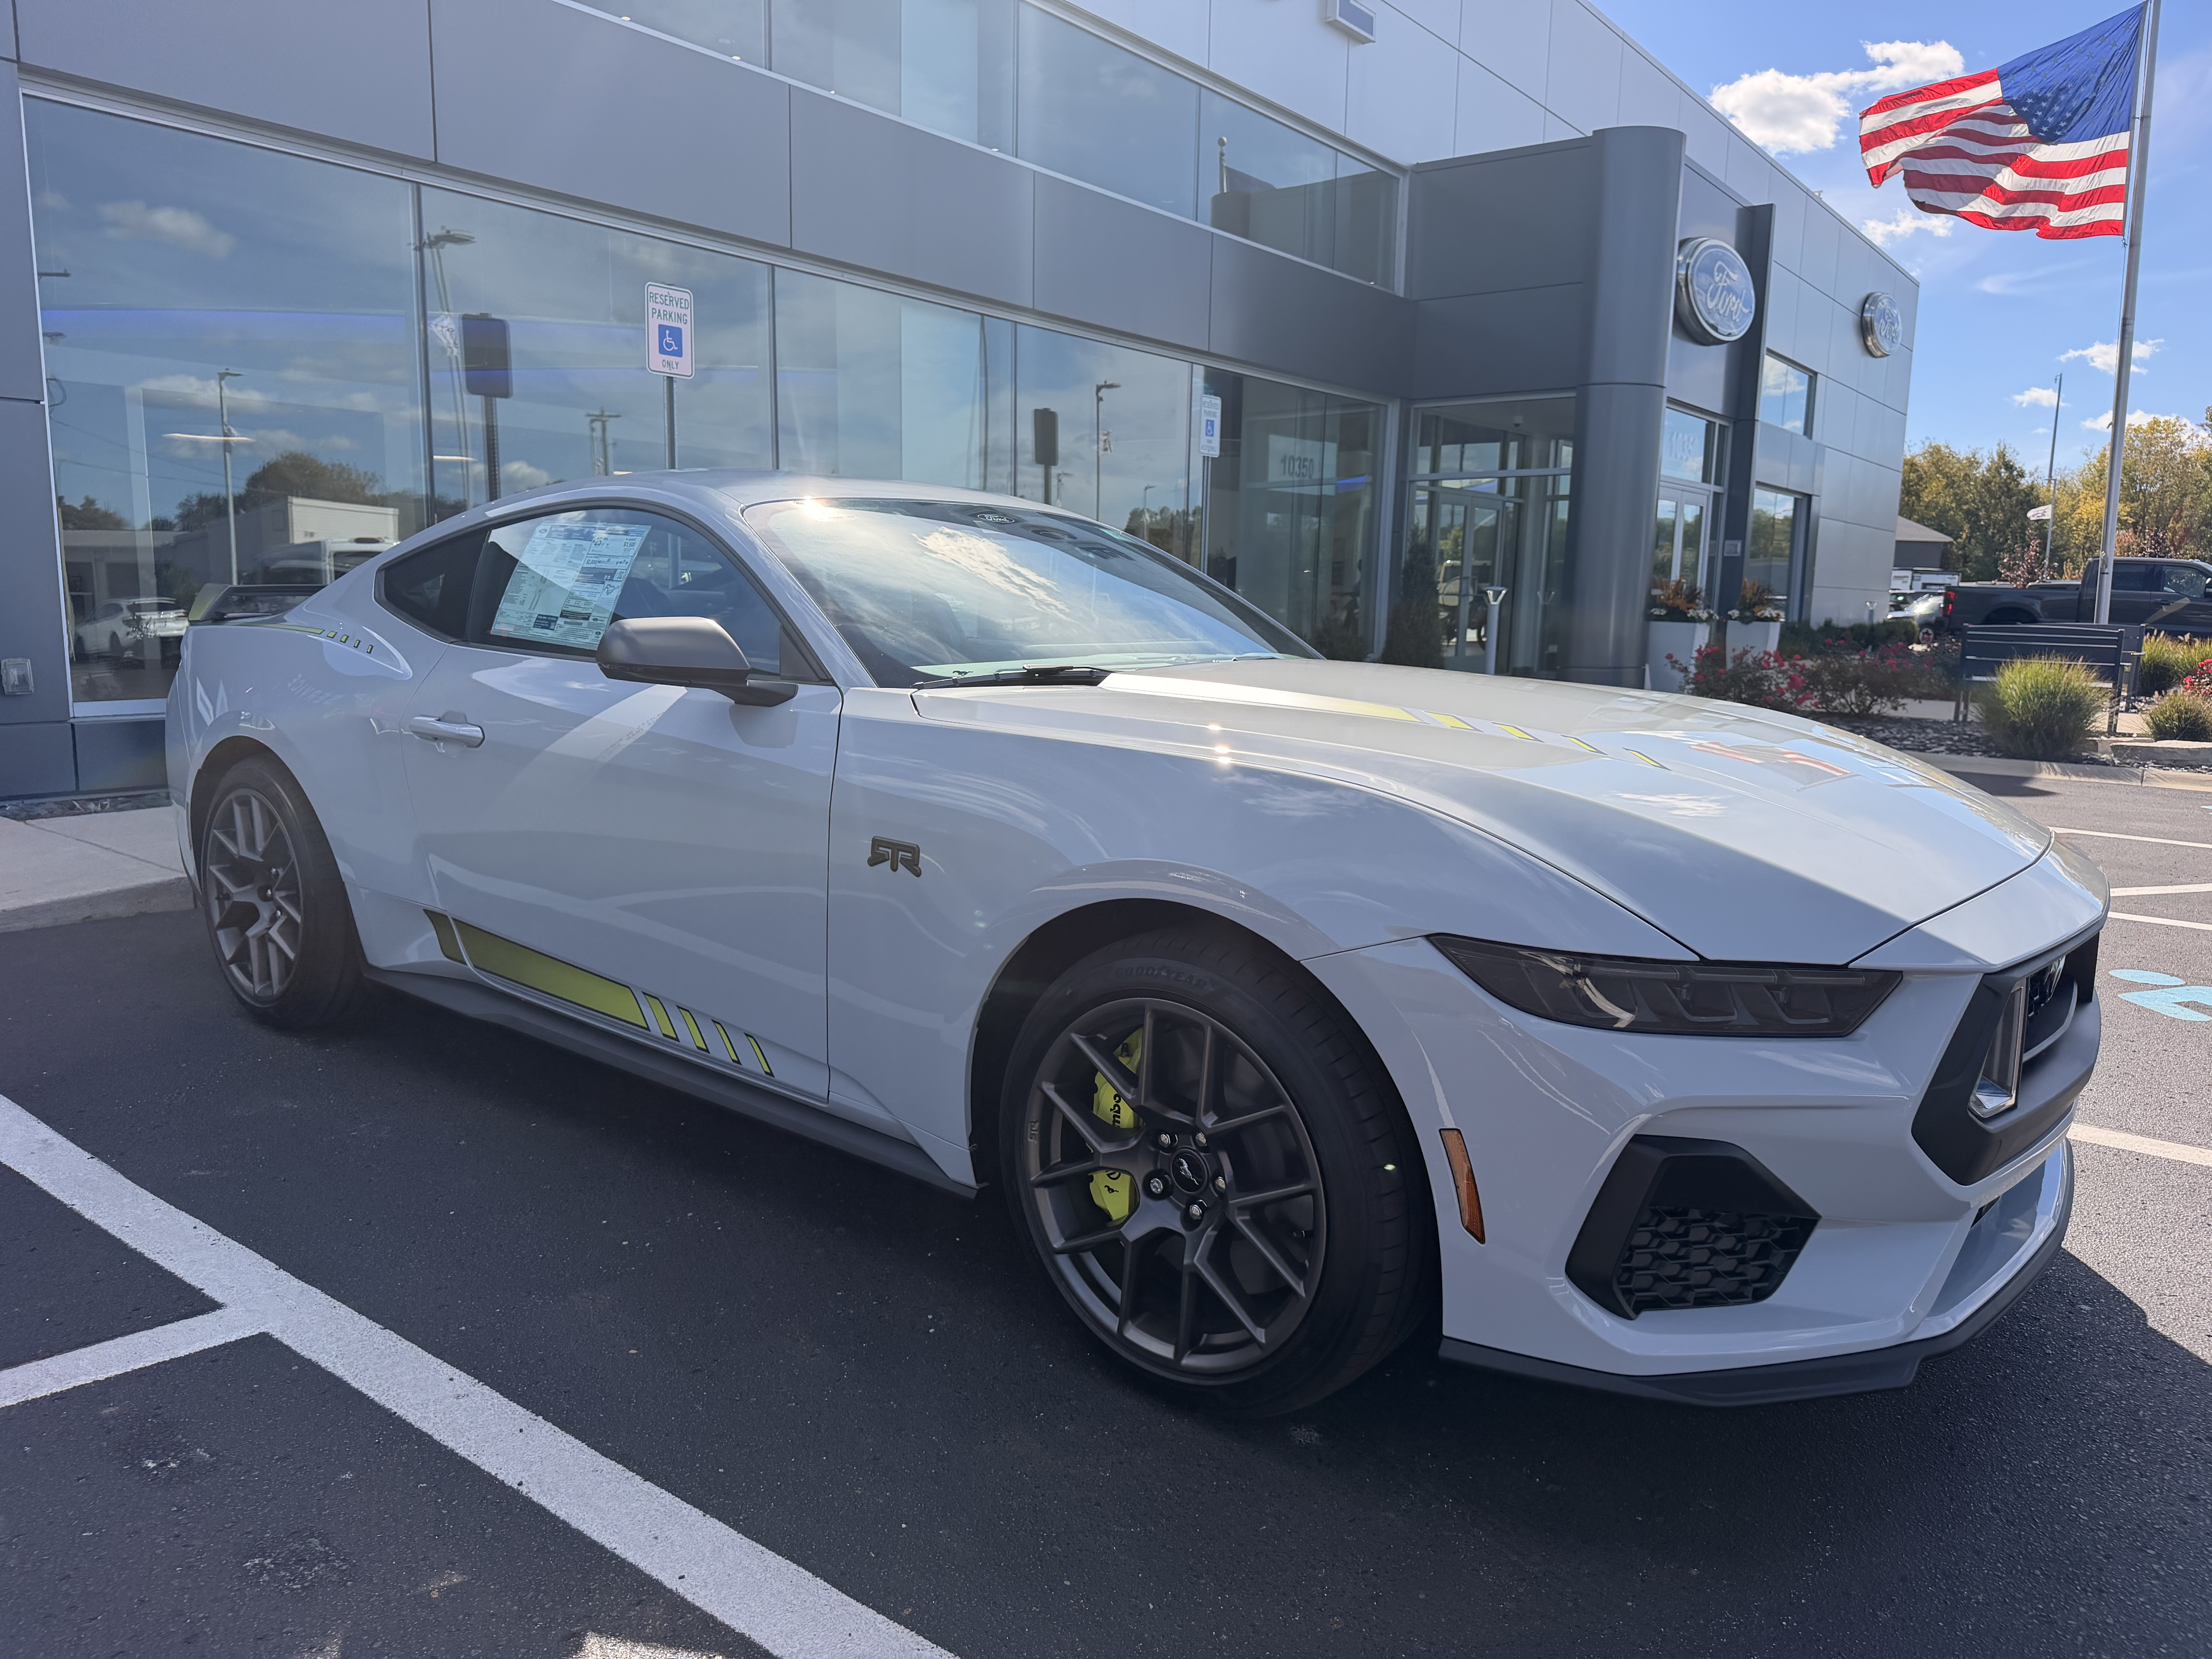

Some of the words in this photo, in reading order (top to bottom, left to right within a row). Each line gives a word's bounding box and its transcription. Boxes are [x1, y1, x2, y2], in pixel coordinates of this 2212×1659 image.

[649, 292, 689, 309] RESERVED
[1707, 261, 1750, 323] Ford
[652, 308, 687, 325] PARKING
[1879, 307, 1898, 344] Ford
[662, 359, 679, 369] ONLY
[1281, 454, 1314, 479] 10350
[1115, 966, 1207, 989] GOODYEAR
[1110, 1093, 1121, 1128] mbo
